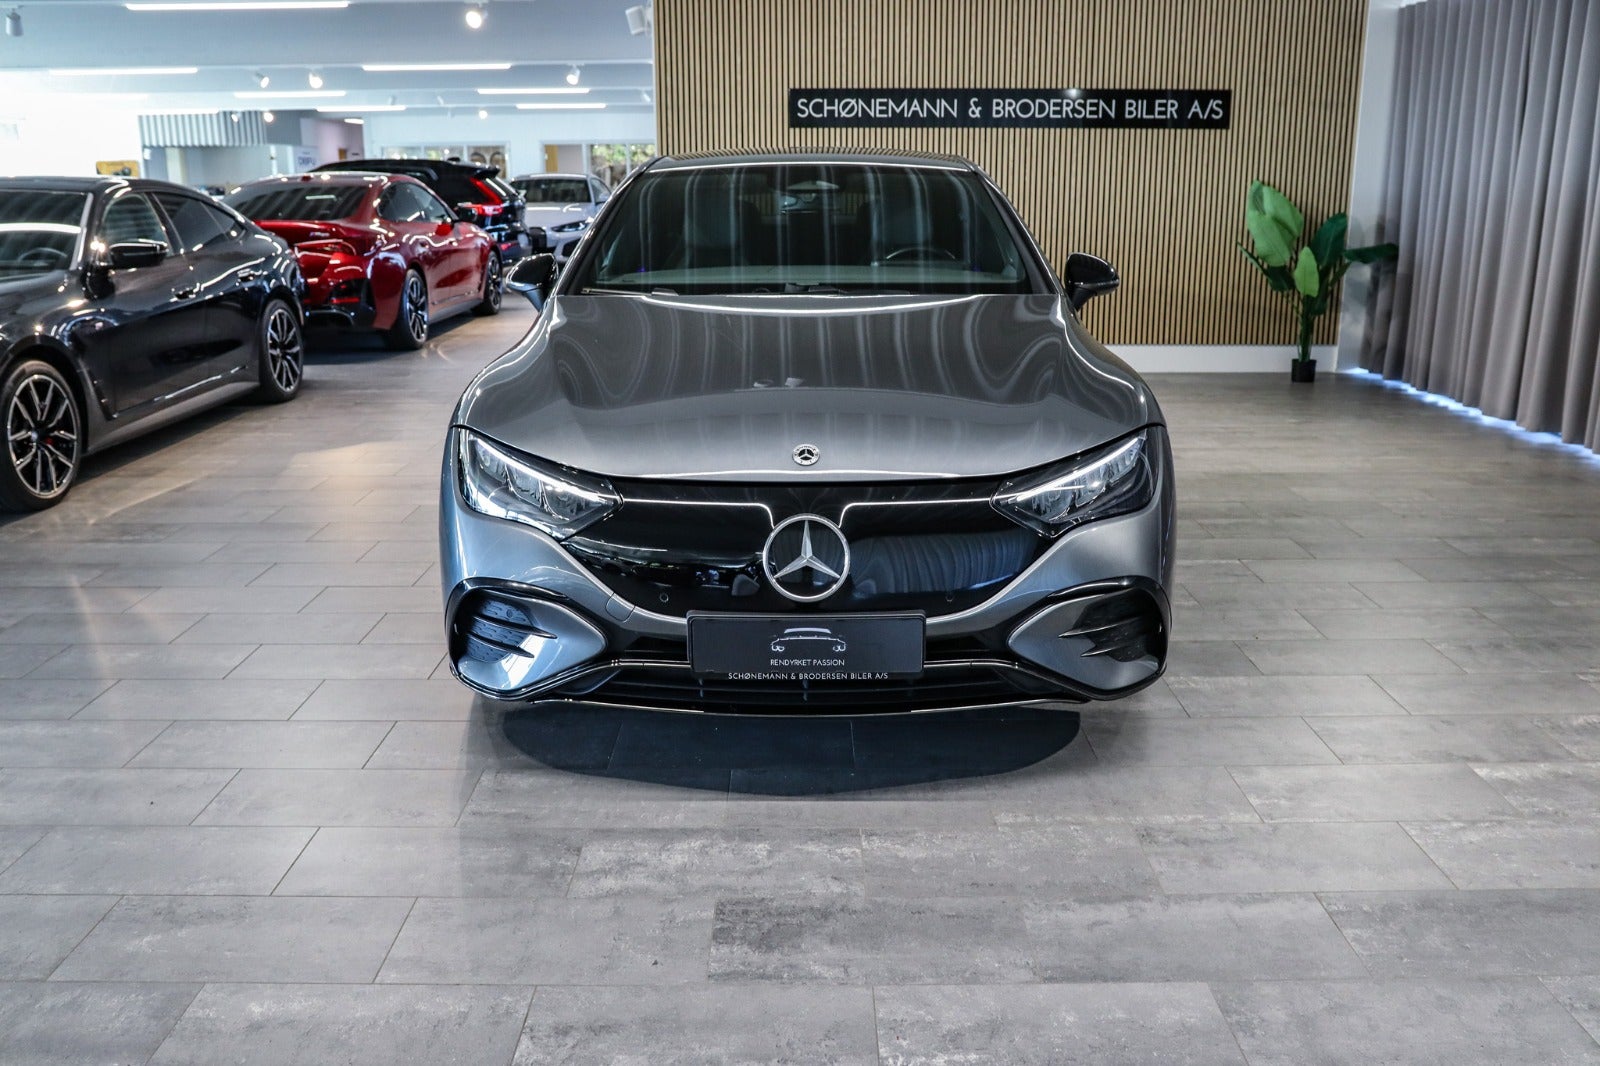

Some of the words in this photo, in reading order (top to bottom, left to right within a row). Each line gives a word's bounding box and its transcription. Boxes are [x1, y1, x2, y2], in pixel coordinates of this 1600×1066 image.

[797, 97, 958, 119] SCHØNEMANN
[968, 98, 982, 118] &
[992, 99, 1116, 119] BRODERSEN
[1124, 99, 1179, 119] BILER
[1187, 99, 1223, 119] A/S
[770, 658, 812, 667] RENDYRKET
[812, 658, 846, 667] PASSION
[728, 672, 788, 681] SCHØNEMANN
[790, 672, 797, 681] &
[798, 672, 848, 681] BRODERSEN
[850, 672, 873, 681] BILER
[874, 672, 889, 680] A/S
